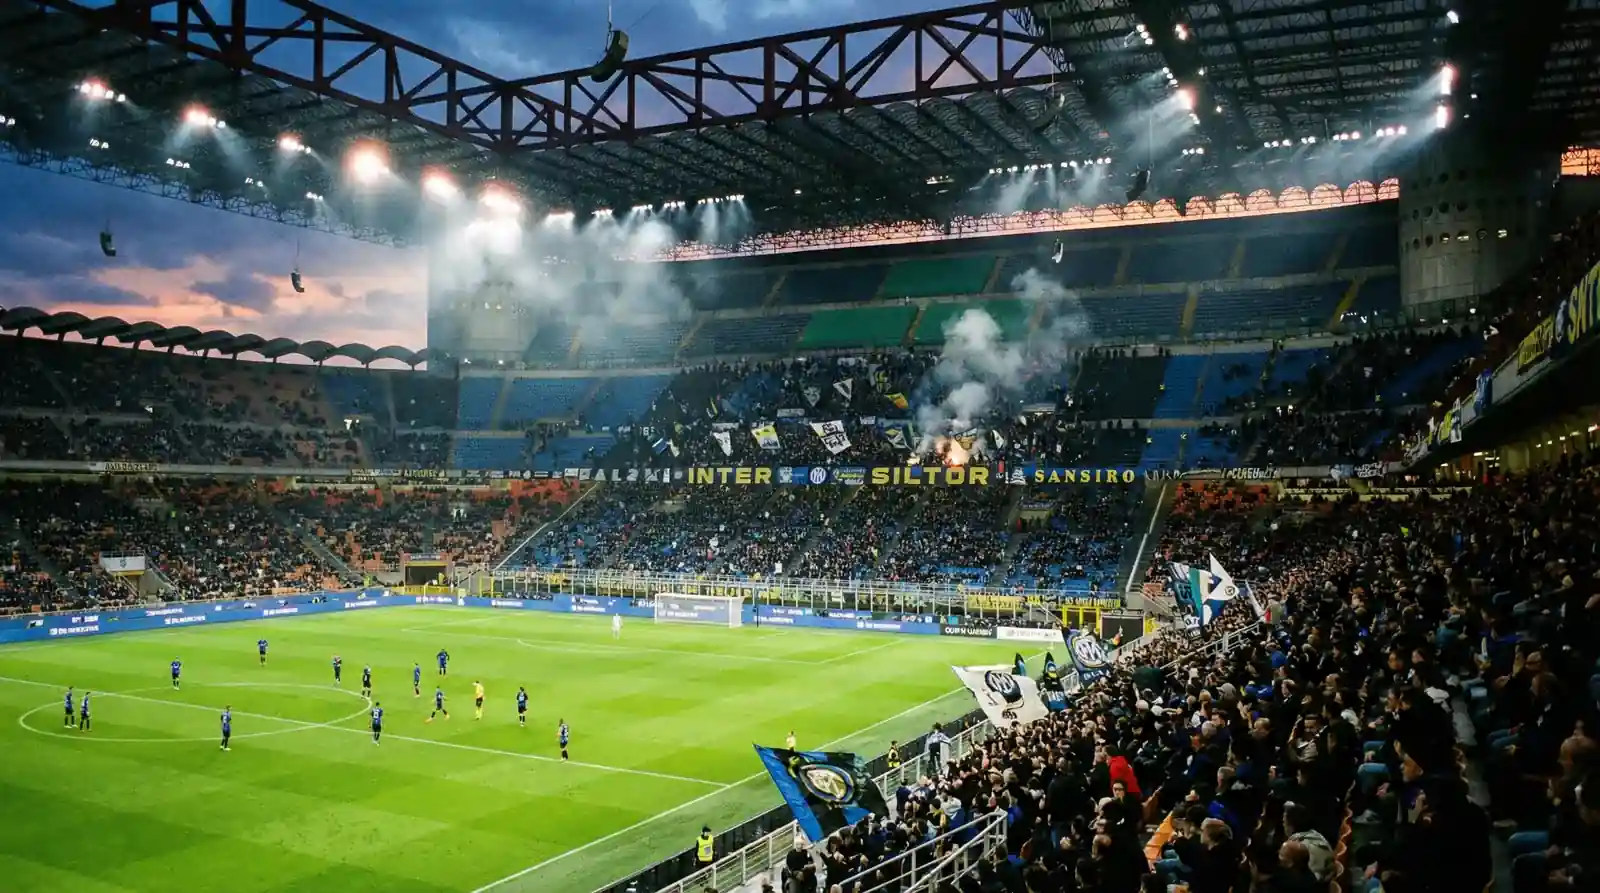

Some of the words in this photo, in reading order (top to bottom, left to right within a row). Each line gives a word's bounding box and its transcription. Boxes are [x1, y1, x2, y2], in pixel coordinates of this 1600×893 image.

[688, 467, 772, 484] INTER
[871, 467, 988, 485] SILTOR
[1034, 468, 1136, 484] SANSIRO
